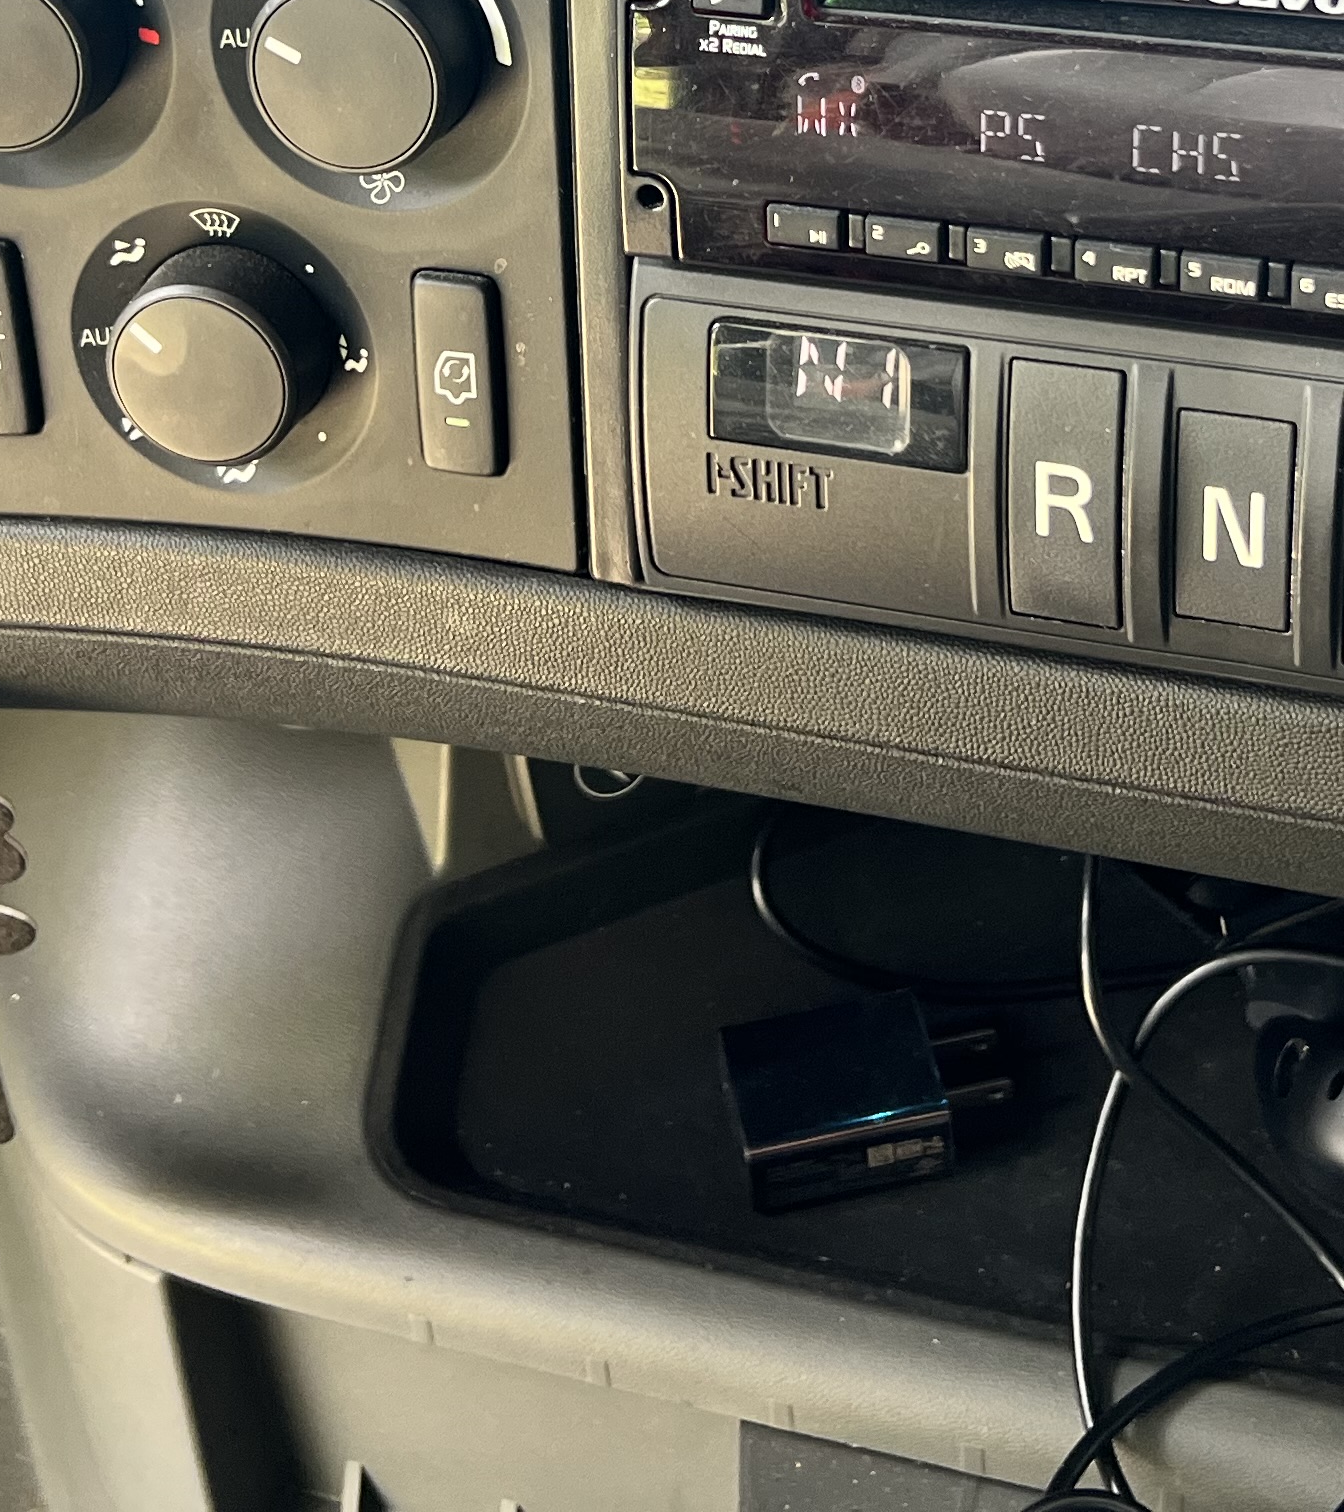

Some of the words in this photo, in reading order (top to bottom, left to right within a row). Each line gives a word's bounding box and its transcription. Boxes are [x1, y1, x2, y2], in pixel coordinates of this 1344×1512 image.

[980, 109, 1046, 163] PS
[1132, 124, 1242, 182] CHS
[871, 224, 884, 240] 2
[973, 238, 987, 254] 3
[1081, 250, 1096, 267] 4
[1112, 265, 1148, 285] RPT
[1210, 275, 1256, 297] RDM
[80, 326, 114, 348] AU
[1034, 460, 1095, 545] R
[1201, 484, 1267, 570] N
